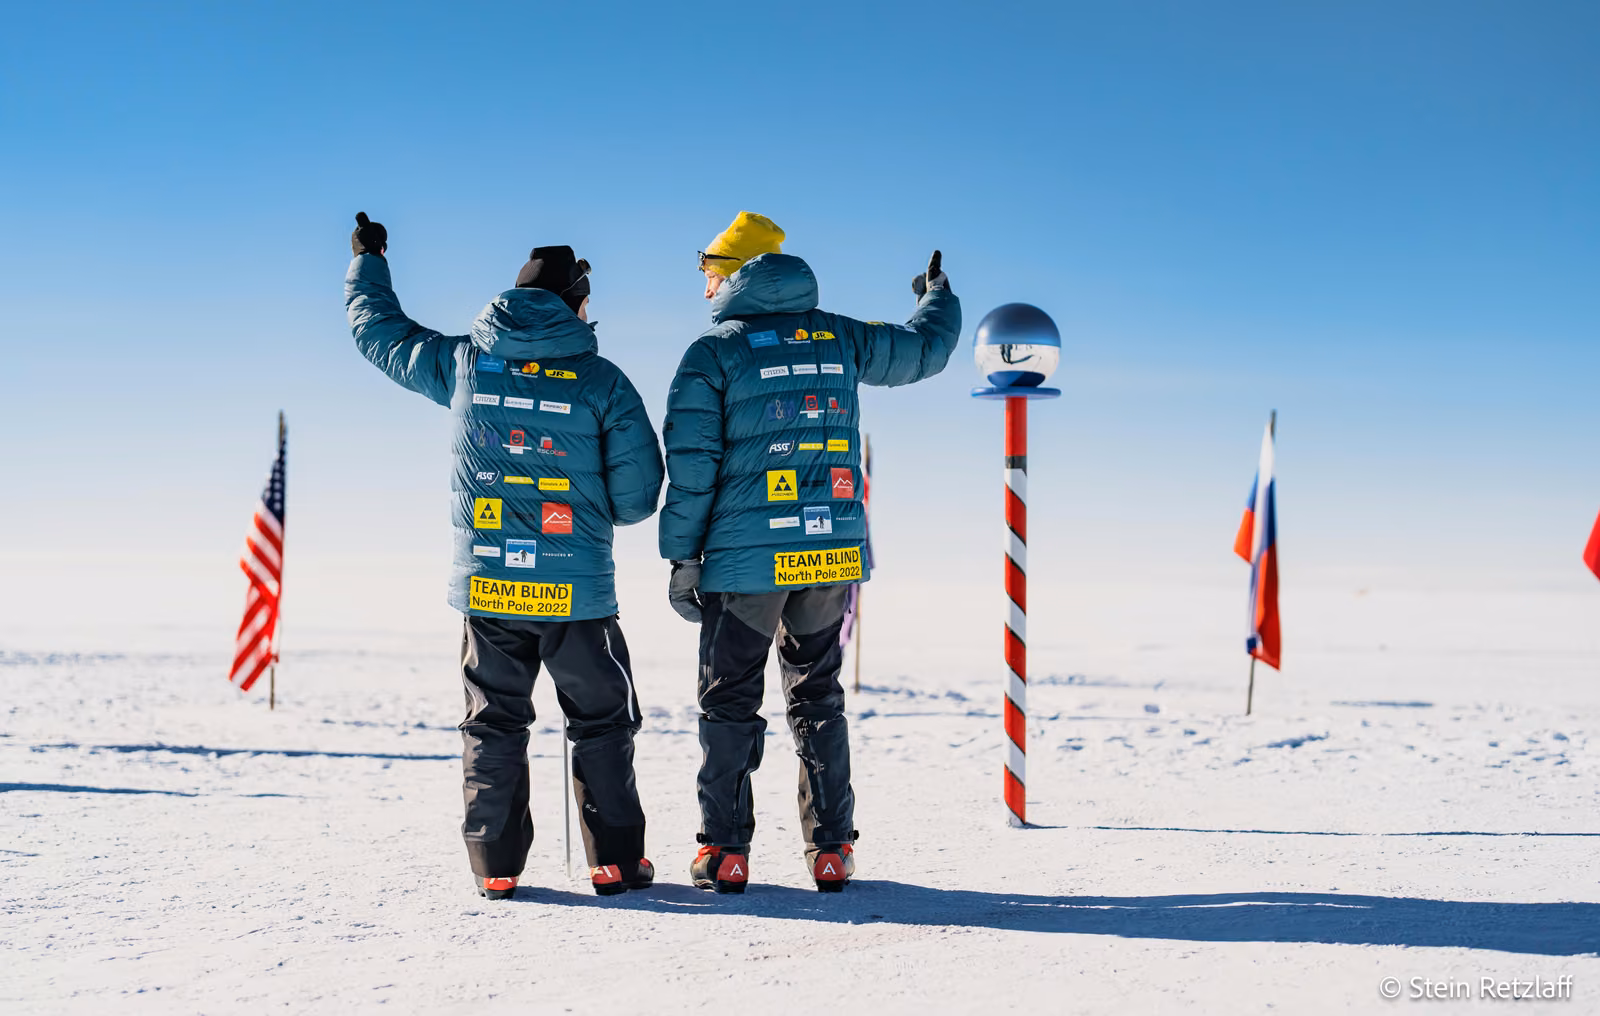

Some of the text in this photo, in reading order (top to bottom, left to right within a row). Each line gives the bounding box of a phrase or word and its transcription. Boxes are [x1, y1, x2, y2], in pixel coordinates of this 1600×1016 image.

[549, 370, 565, 378] JR
[763, 368, 786, 377] CITIZEN
[475, 395, 498, 404] CITIZEN
[769, 442, 791, 454] ASG
[476, 471, 496, 481] ASG
[778, 550, 859, 568] TEAM BLIND
[778, 565, 860, 582] North Pole 2022
[473, 579, 569, 600] TEAM BLIND
[472, 596, 568, 613] North Pole 2022
